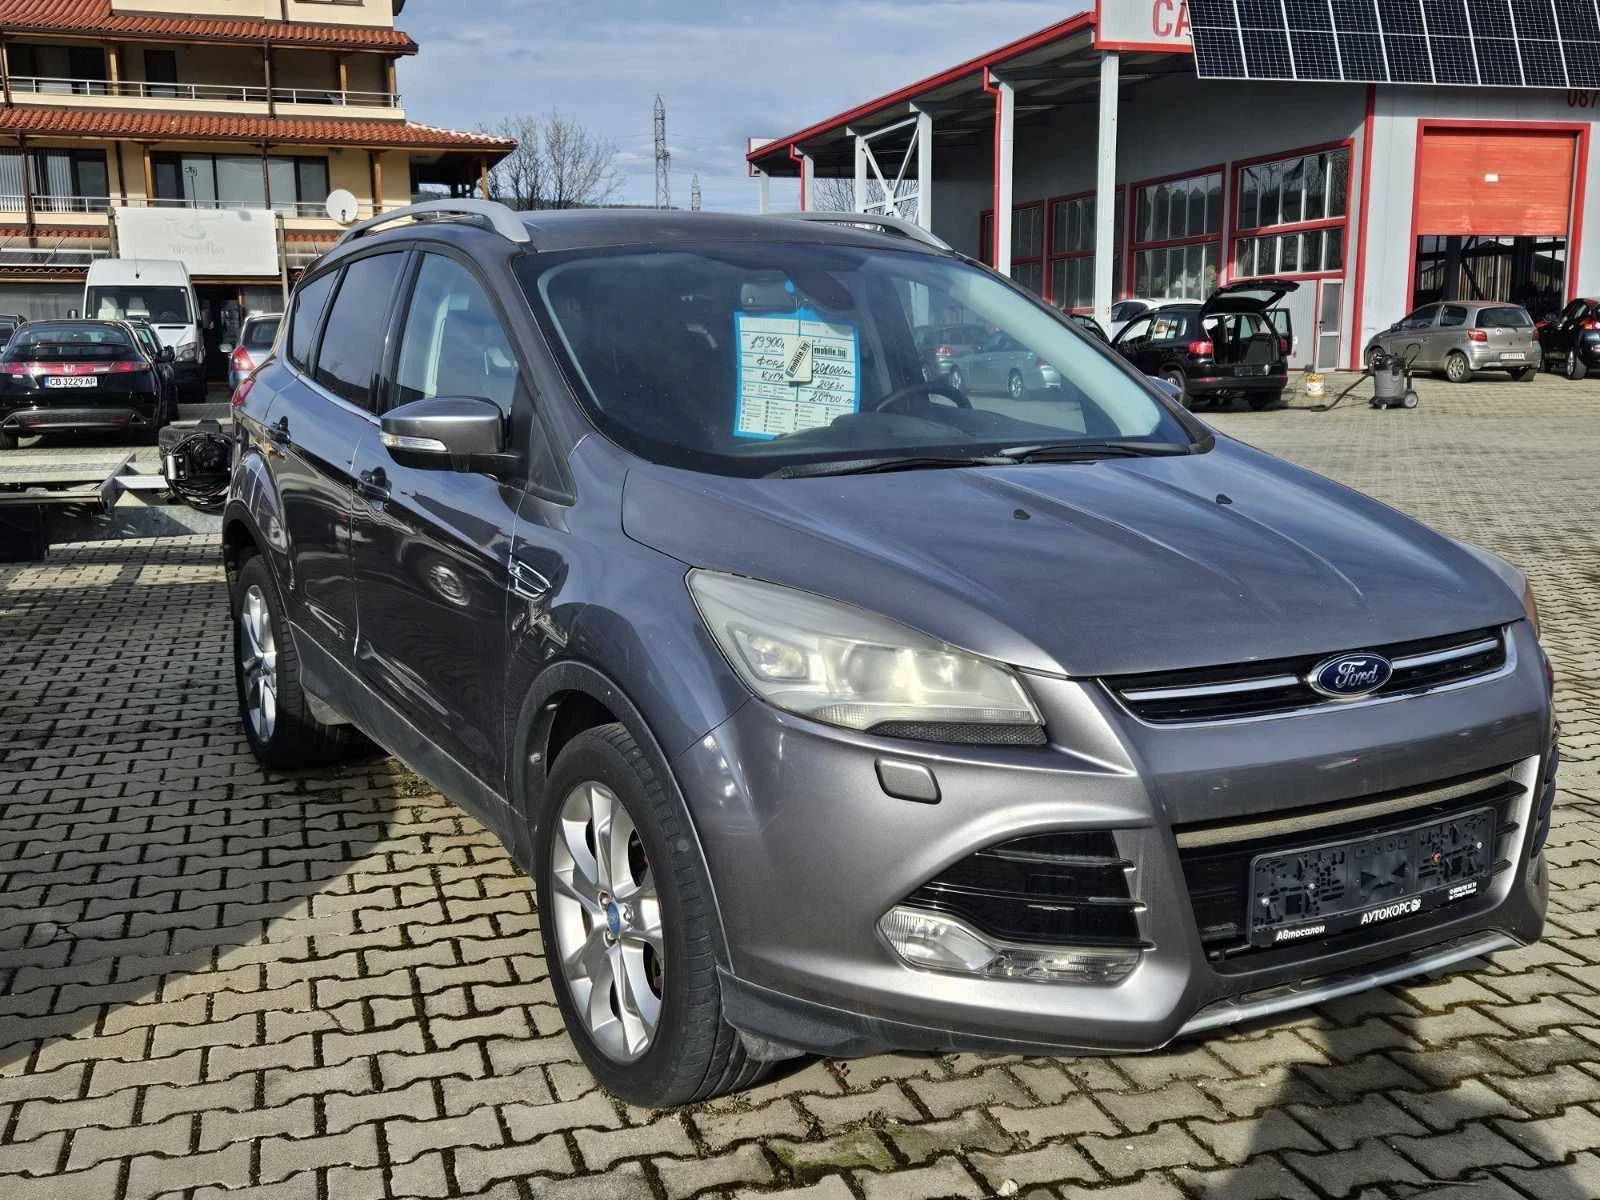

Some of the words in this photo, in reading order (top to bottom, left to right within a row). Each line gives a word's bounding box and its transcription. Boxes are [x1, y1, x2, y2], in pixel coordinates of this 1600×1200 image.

[1335, 660, 1379, 689] Ford
[1361, 901, 1411, 925] АУТОКОРС
[1276, 925, 1326, 941] Автосалон
